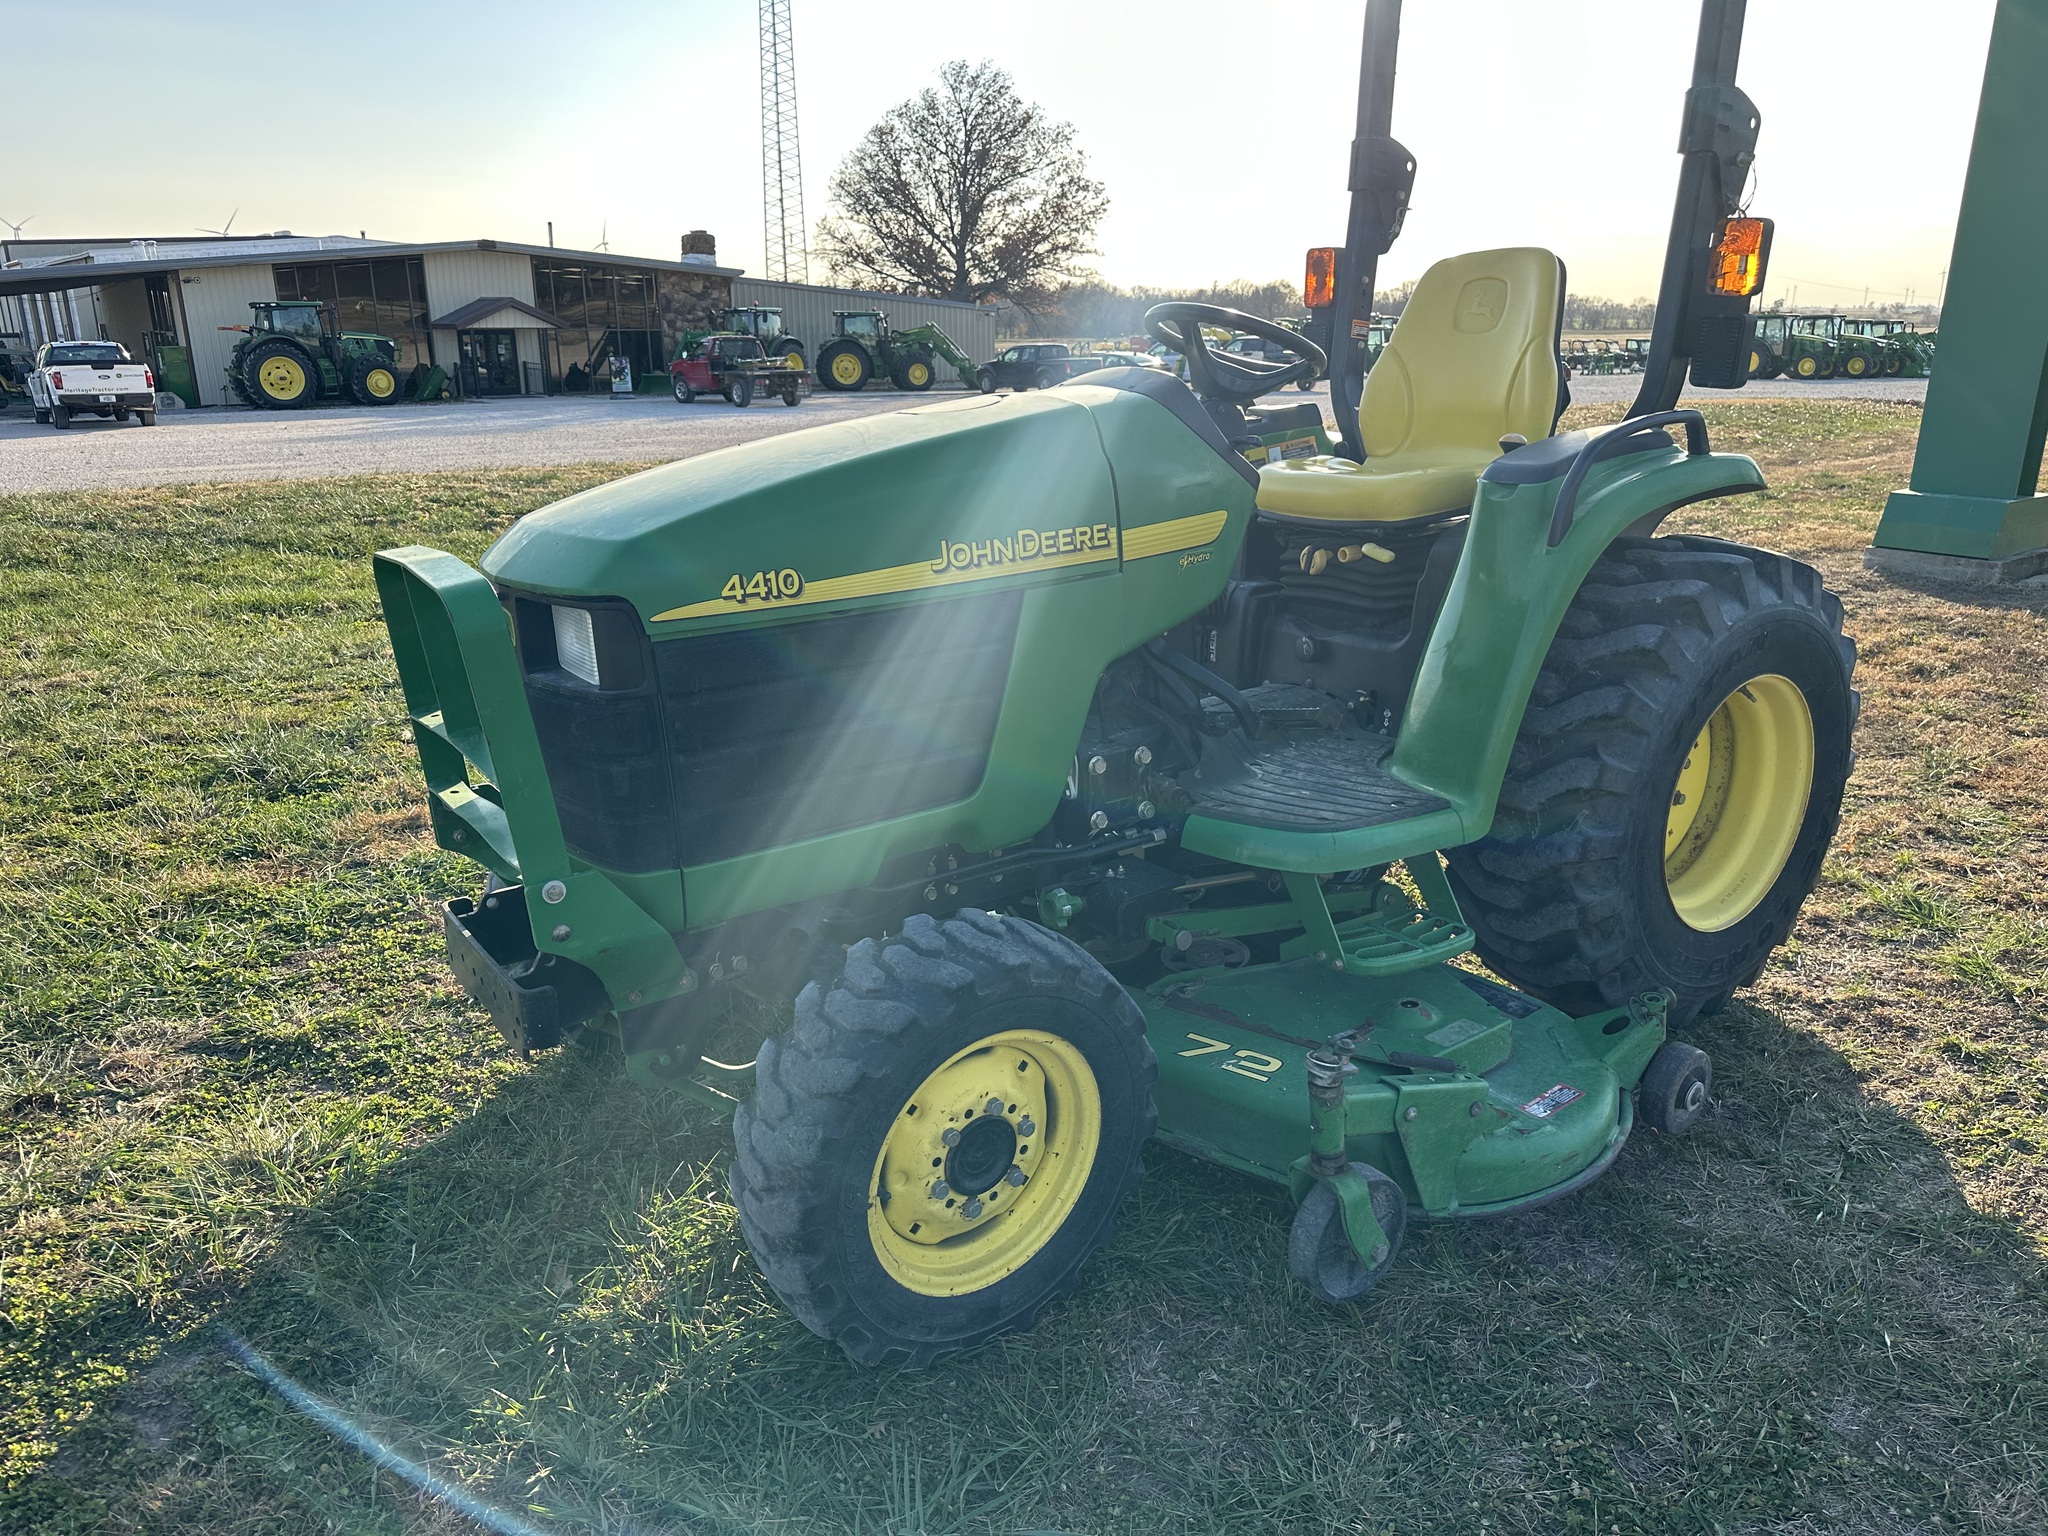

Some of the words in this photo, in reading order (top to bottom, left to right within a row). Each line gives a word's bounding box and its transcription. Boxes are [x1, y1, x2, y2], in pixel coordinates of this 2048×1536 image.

[931, 537, 1018, 575] JOHN
[1016, 523, 1112, 563] DEERE
[720, 567, 804, 604] 4410
[1175, 1031, 1284, 1083] 72
